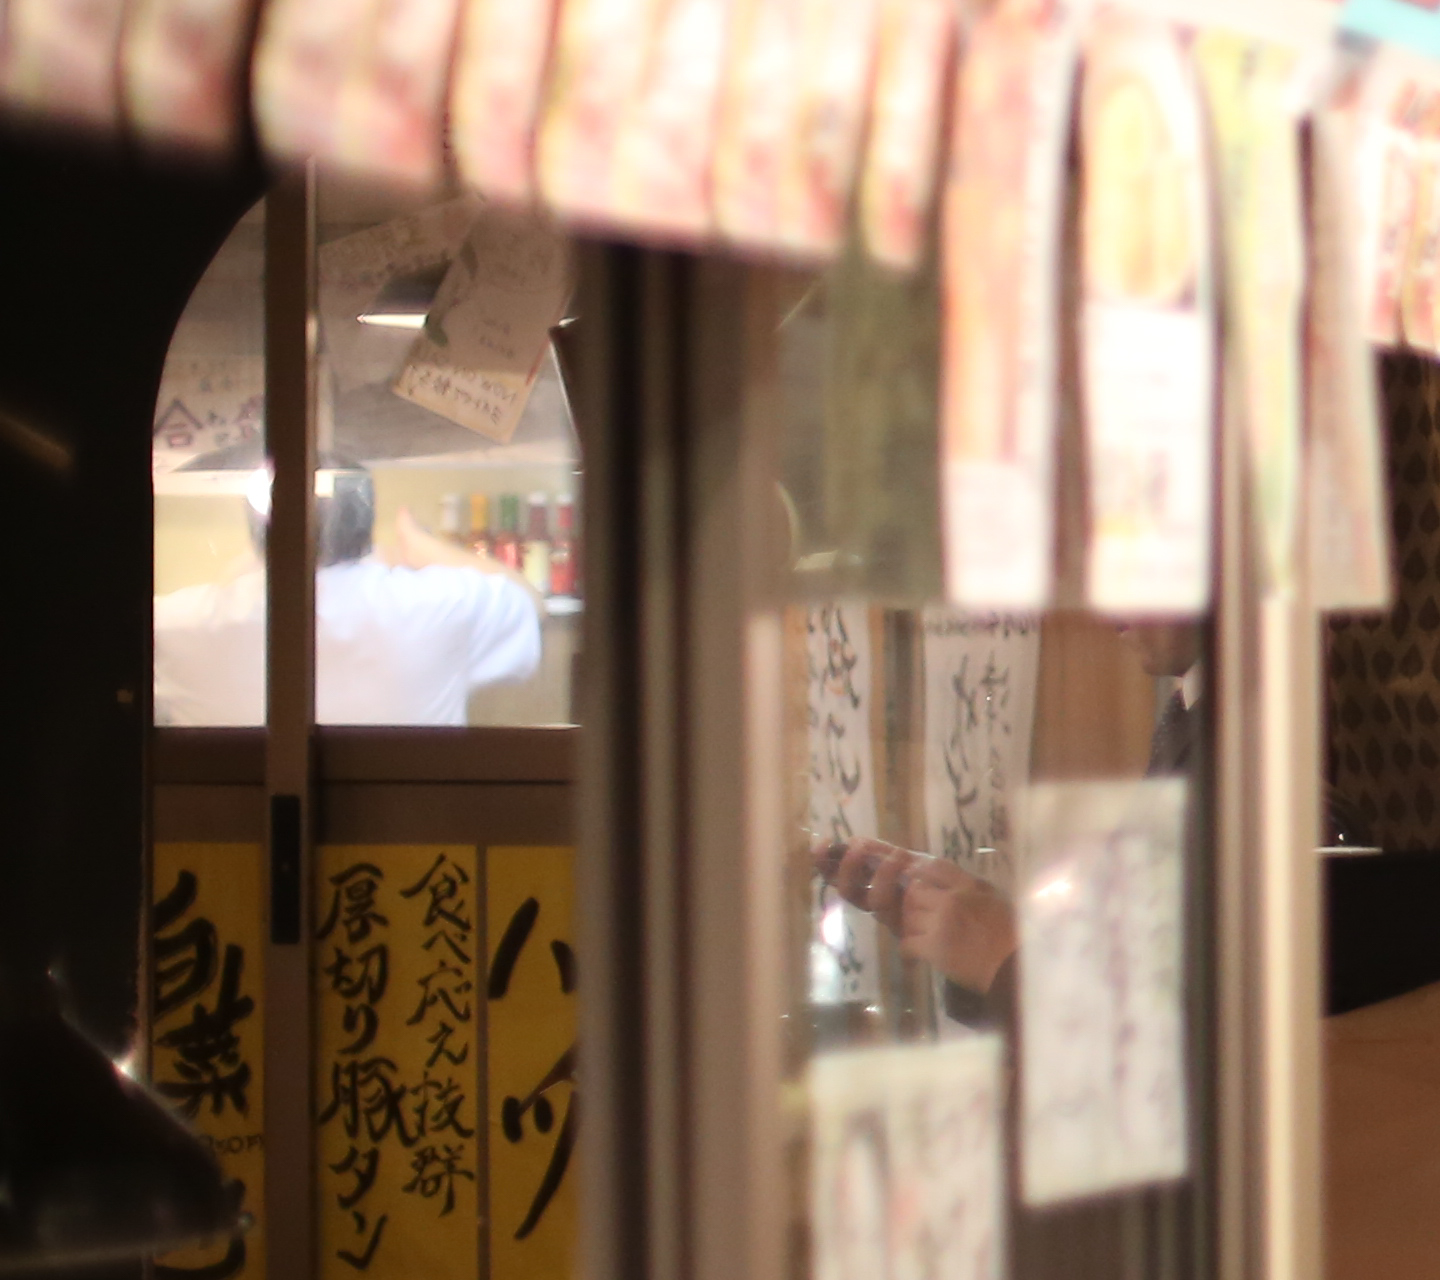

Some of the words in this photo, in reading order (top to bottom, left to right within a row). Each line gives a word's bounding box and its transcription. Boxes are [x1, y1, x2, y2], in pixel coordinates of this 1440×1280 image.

[315, 861, 421, 1272] 厚切り豚タン
[400, 852, 477, 1220] 食べ応え抜群
